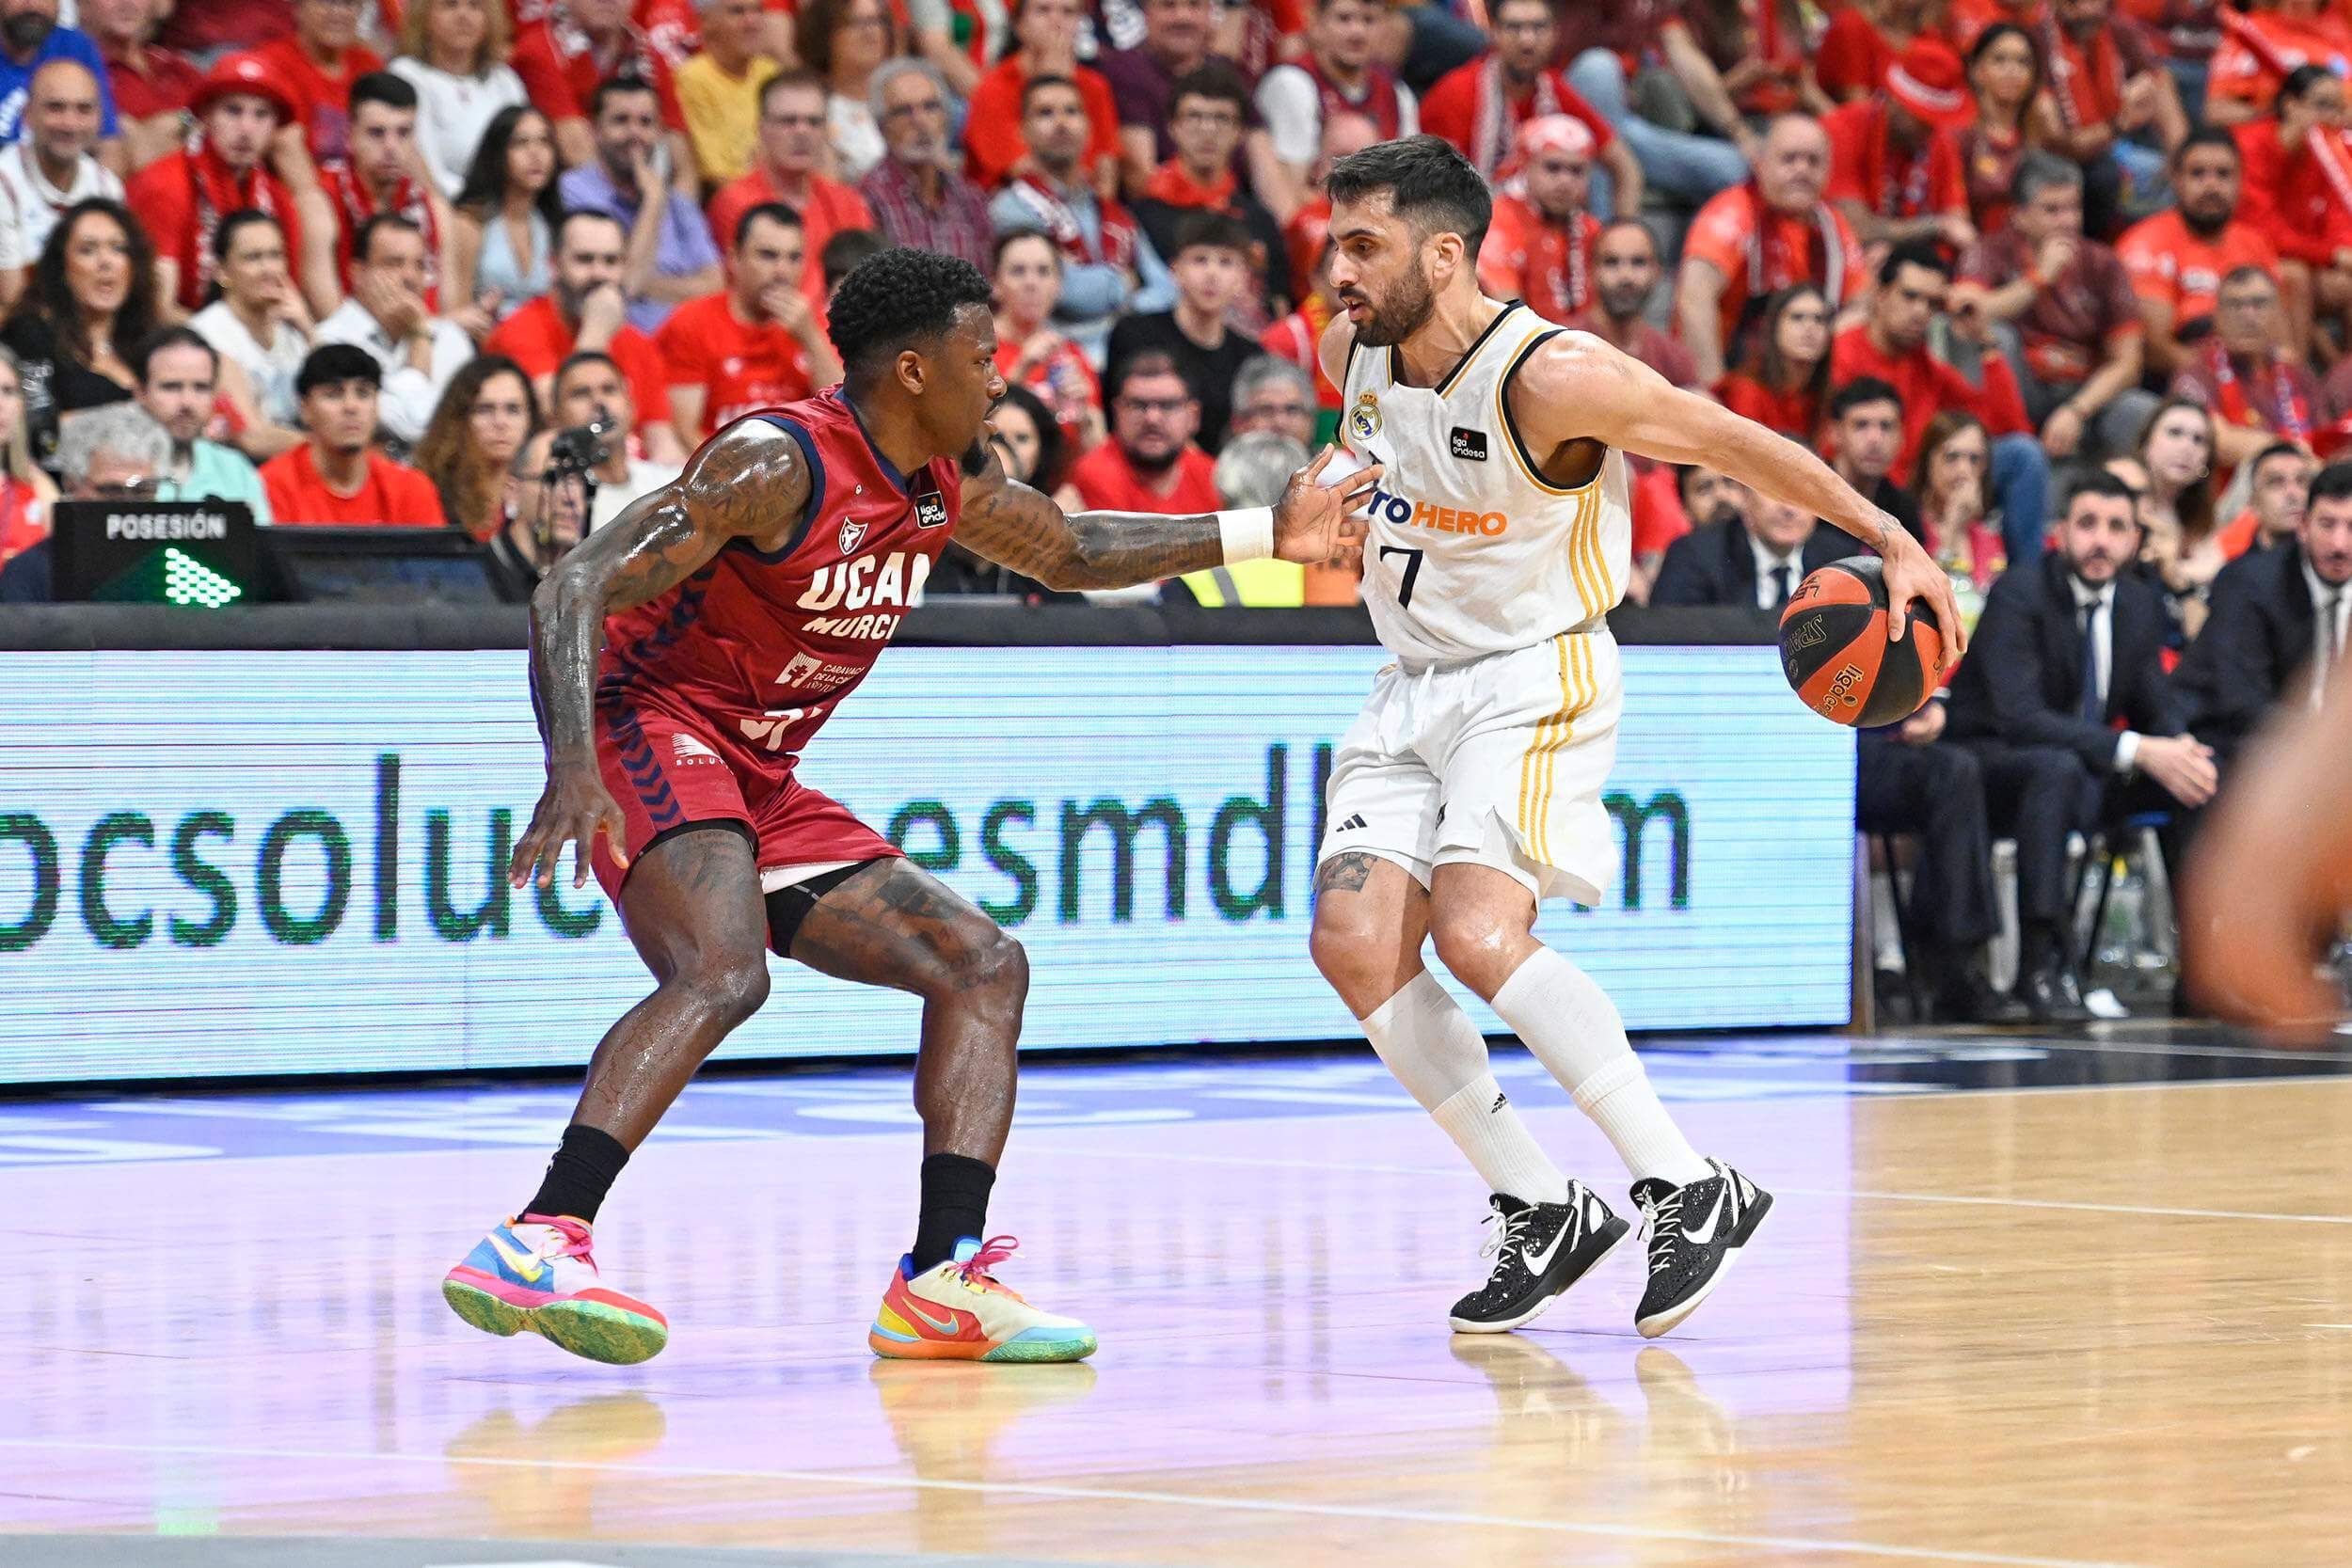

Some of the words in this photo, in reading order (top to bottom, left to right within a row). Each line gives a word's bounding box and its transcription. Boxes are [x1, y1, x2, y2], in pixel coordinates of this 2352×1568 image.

[1453, 446, 1486, 459] endesa
[96, 508, 228, 540] POSESIÓN
[1367, 490, 1508, 537] TOHERO
[1379, 545, 1424, 611] 7
[801, 613, 901, 641] MURCI
